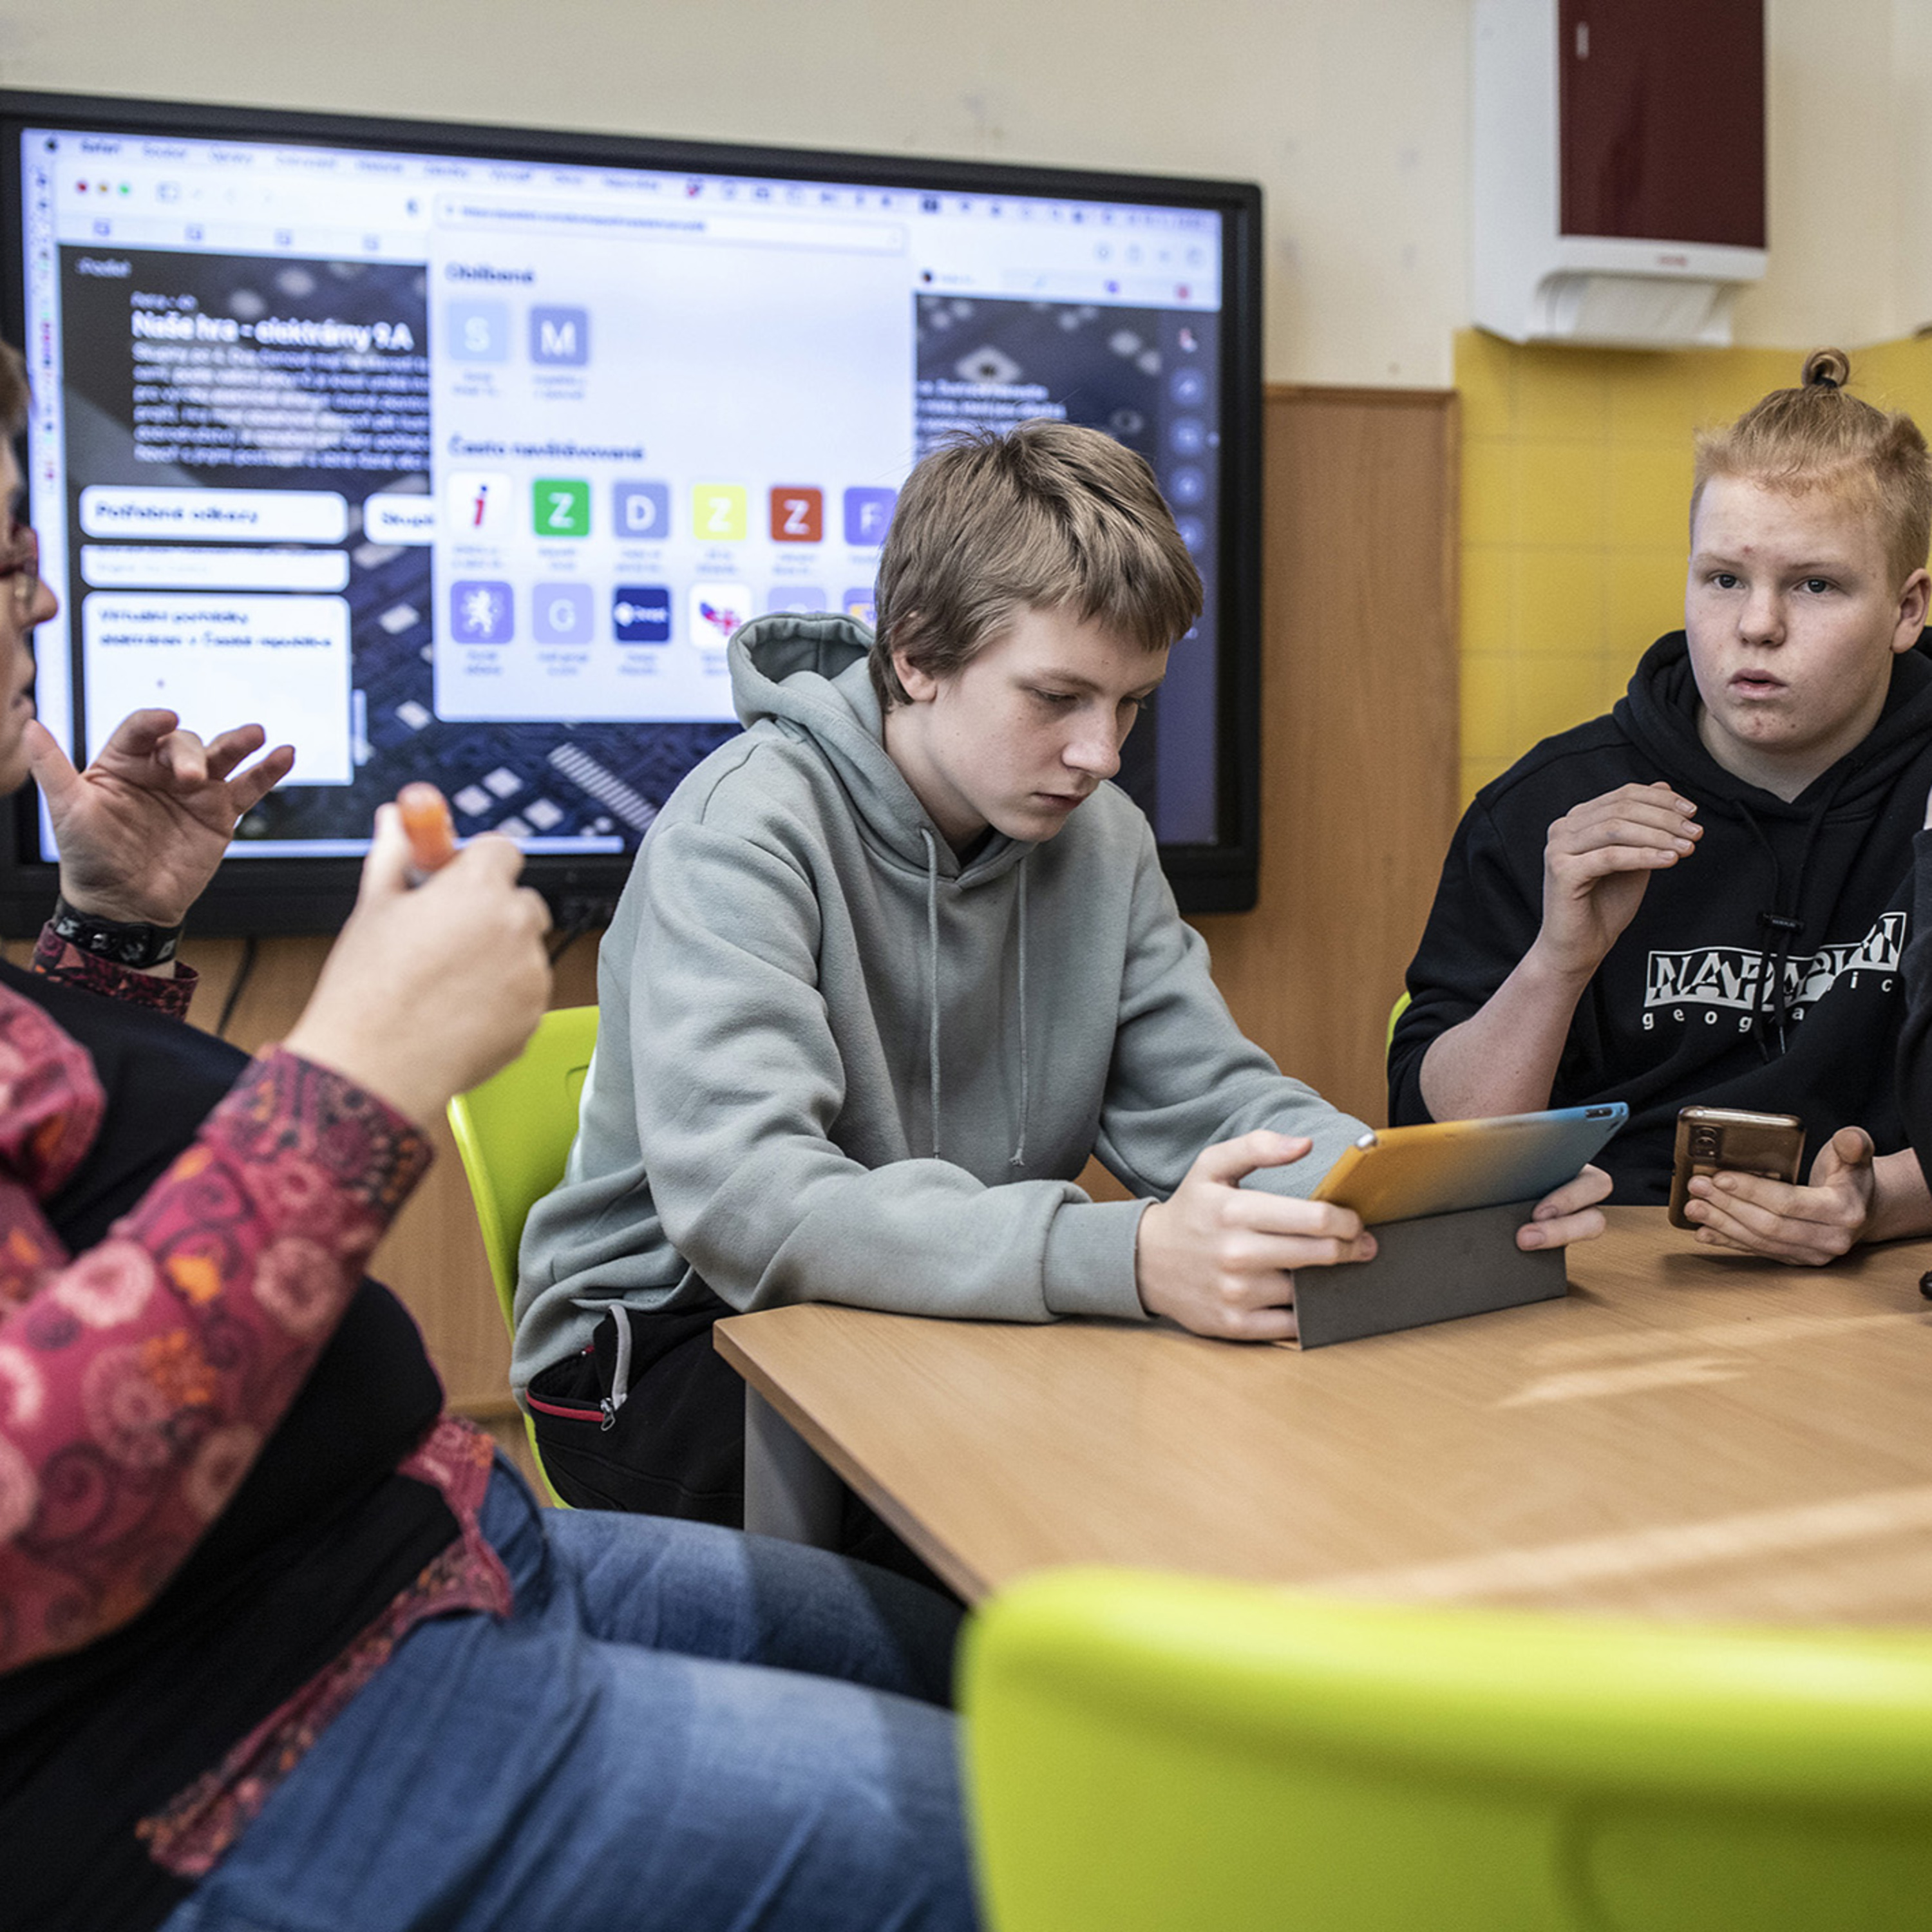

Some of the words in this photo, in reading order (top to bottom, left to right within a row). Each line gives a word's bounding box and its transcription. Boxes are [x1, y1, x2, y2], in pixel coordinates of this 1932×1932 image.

[132, 310, 193, 341] Naše
[195, 312, 239, 343] hra
[464, 316, 490, 352] S
[540, 320, 576, 356] M
[548, 491, 575, 529] Z
[626, 494, 656, 531] D
[707, 497, 732, 533] Z
[783, 498, 810, 535] Z
[548, 598, 576, 632] G
